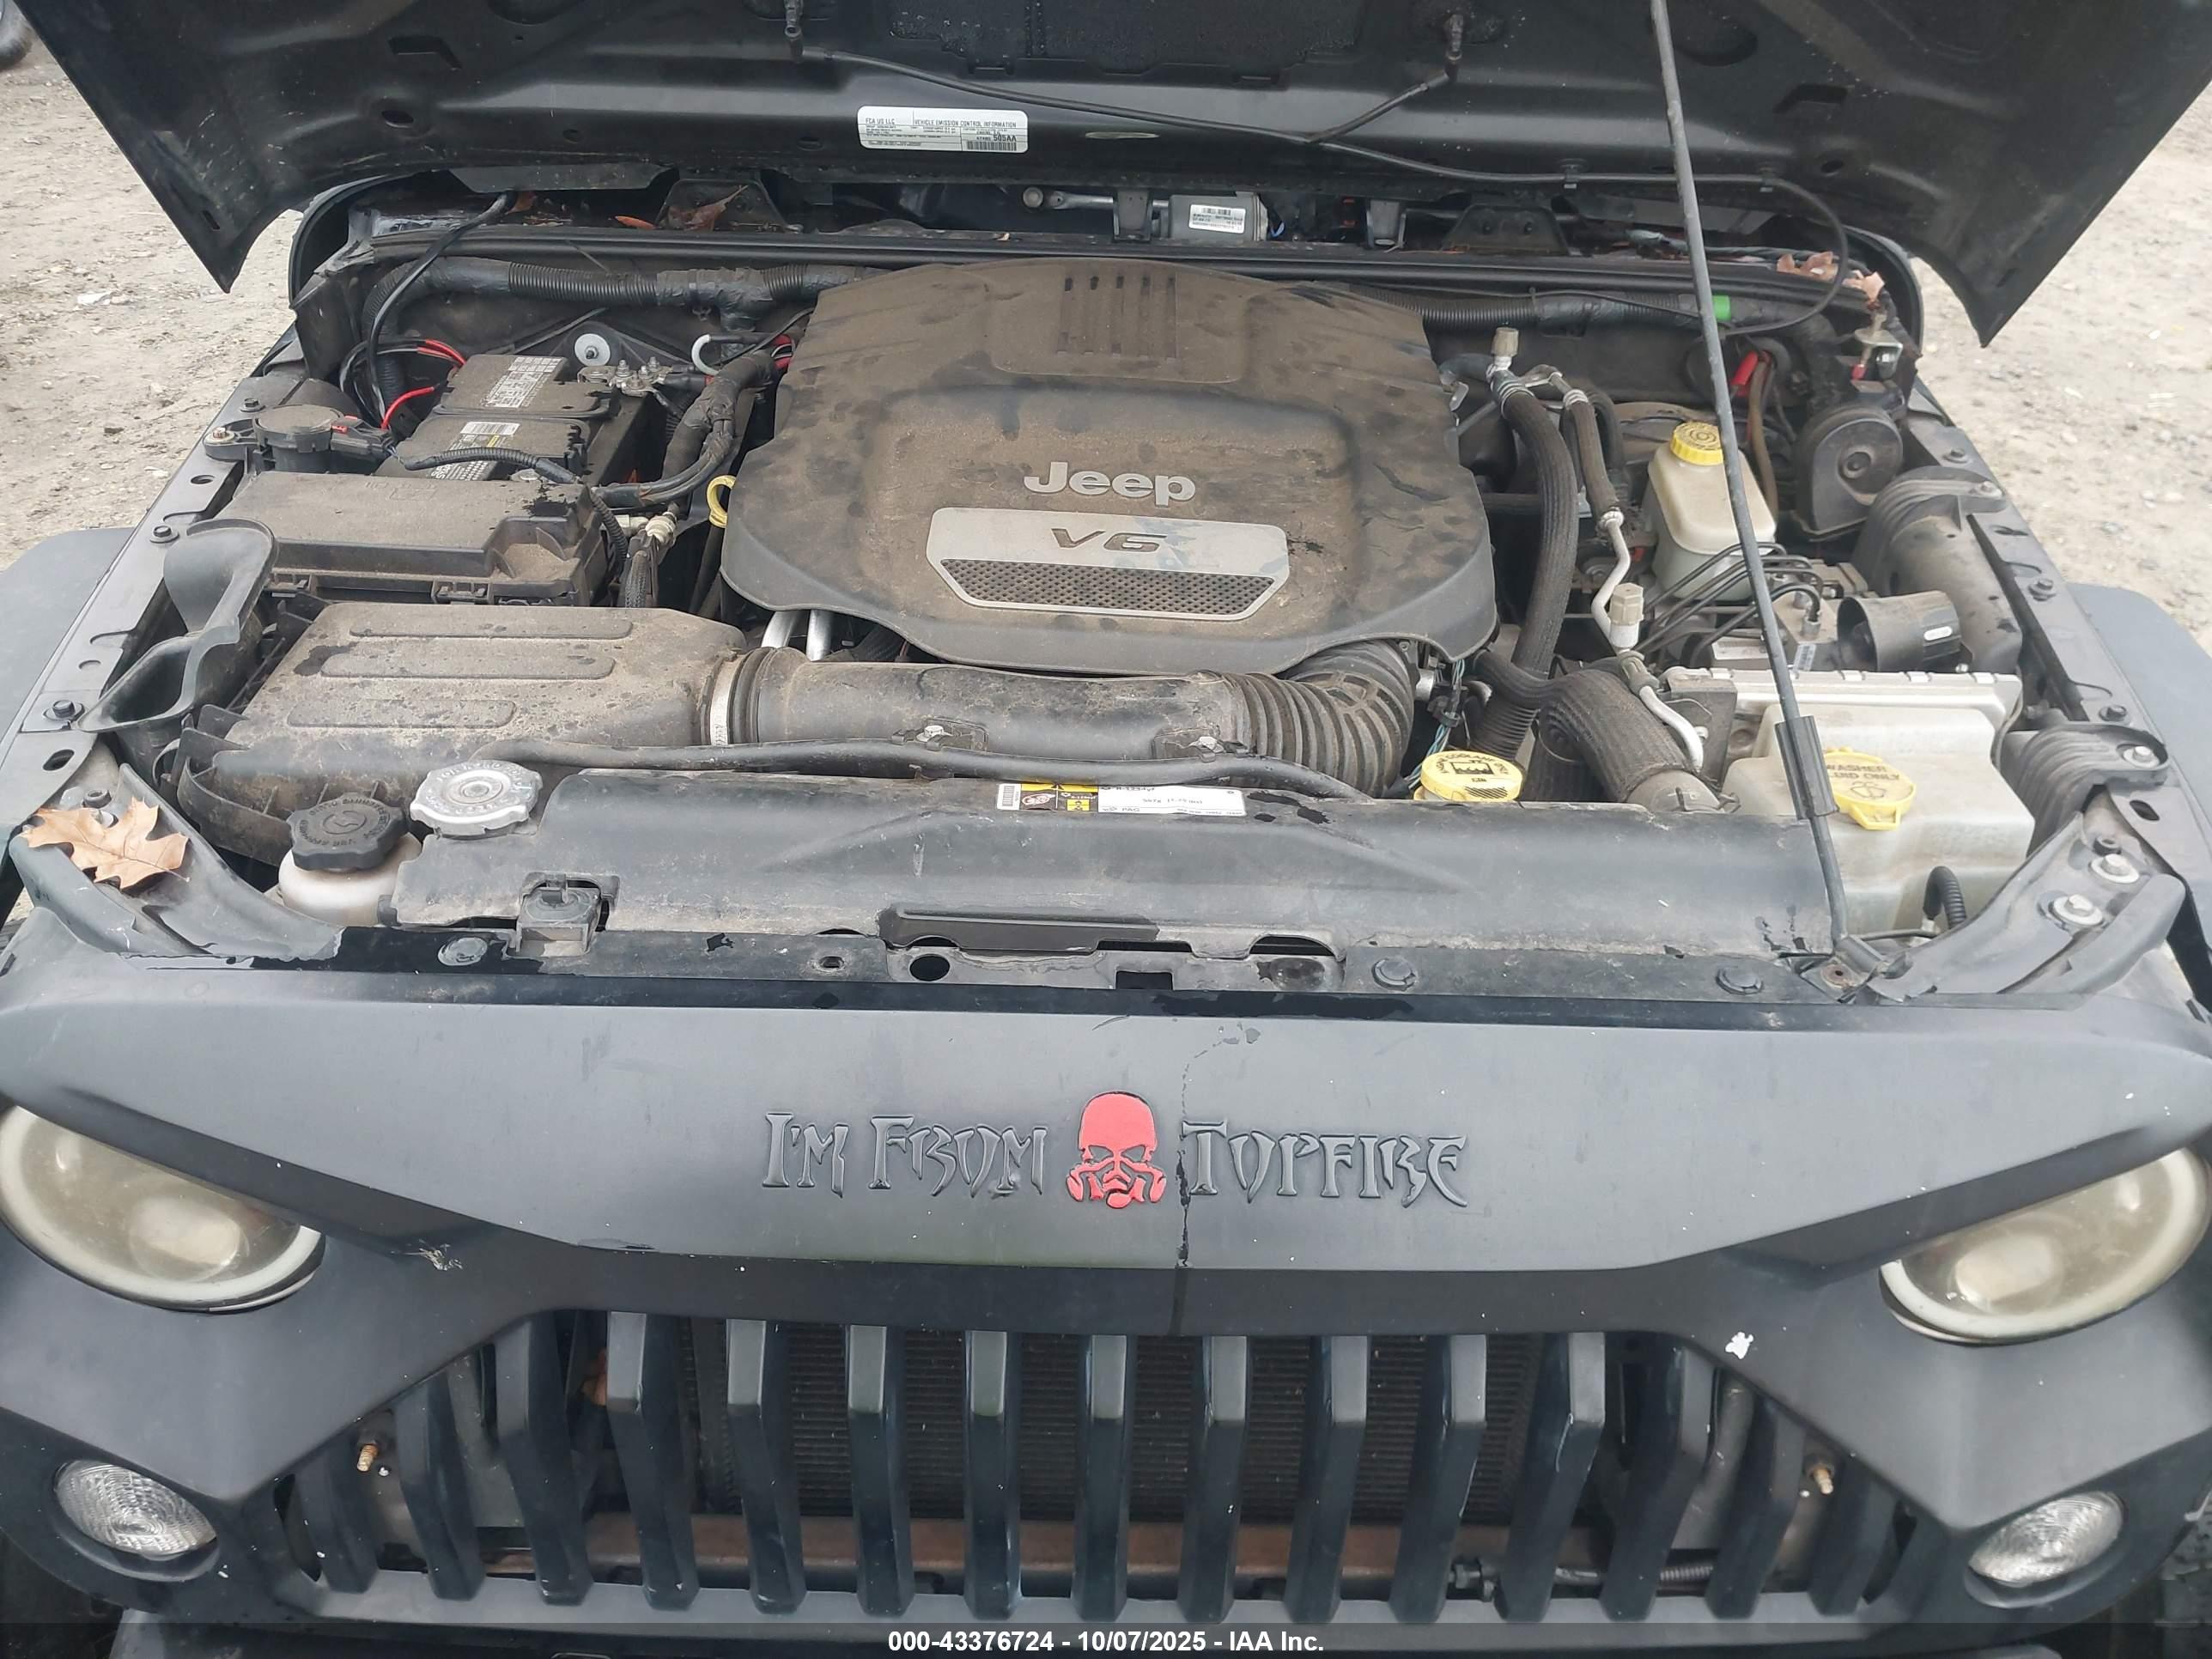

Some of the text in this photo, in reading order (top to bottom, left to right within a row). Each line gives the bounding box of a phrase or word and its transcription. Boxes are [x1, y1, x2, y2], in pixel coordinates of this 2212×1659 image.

[1024, 462, 1196, 507] Jeep
[1051, 527, 1168, 553] V6
[868, 1115, 1048, 1199] FROM
[1182, 1119, 1468, 1208] TOPFIRE
